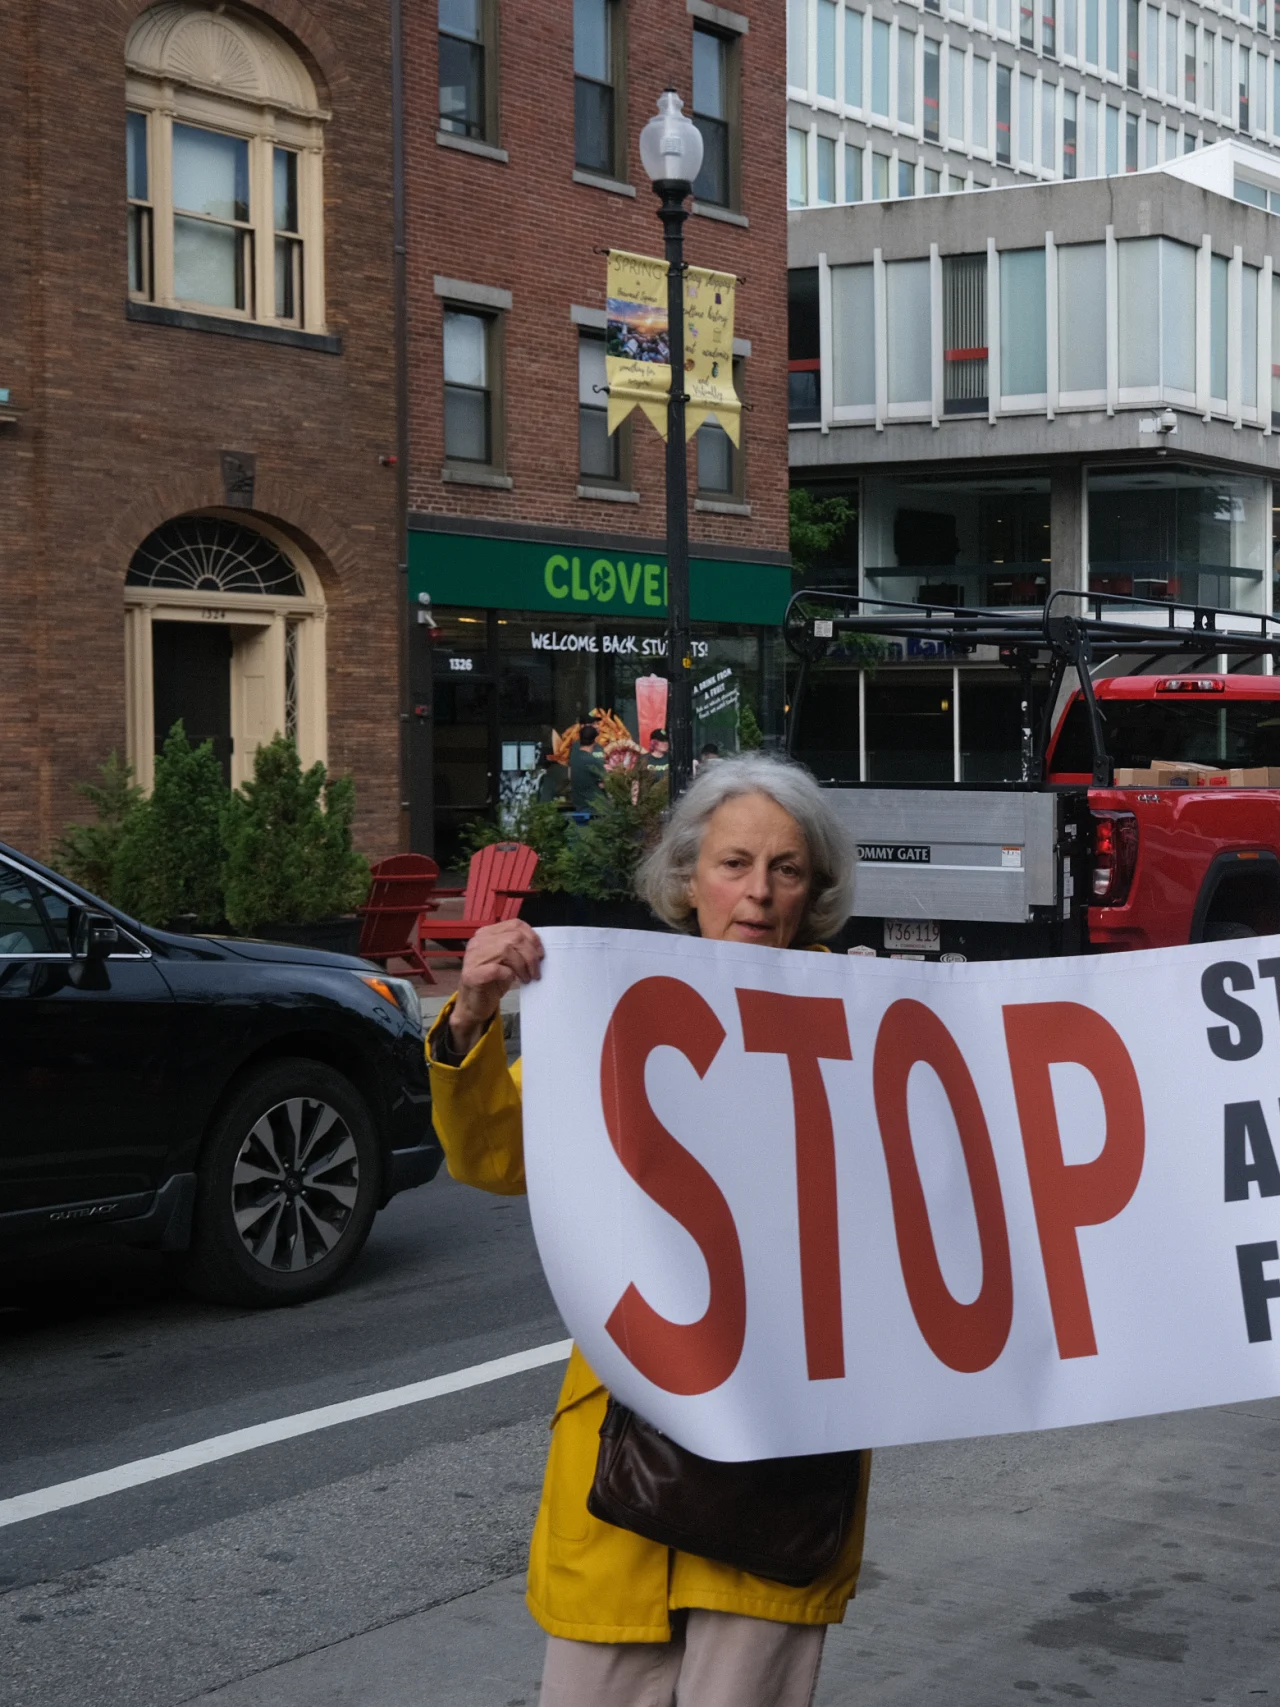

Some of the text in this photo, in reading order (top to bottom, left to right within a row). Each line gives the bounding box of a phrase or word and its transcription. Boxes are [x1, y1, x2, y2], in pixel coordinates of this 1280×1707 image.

[614, 255, 663, 280] SPRING
[544, 554, 668, 607] CLOVE
[531, 631, 708, 658] WELCOME BACK STUTS!
[449, 658, 473, 671] 1326
[857, 846, 929, 861] OMMY GATE
[600, 975, 1146, 1396] STOP
[50, 1203, 119, 1221] OUTBACK
